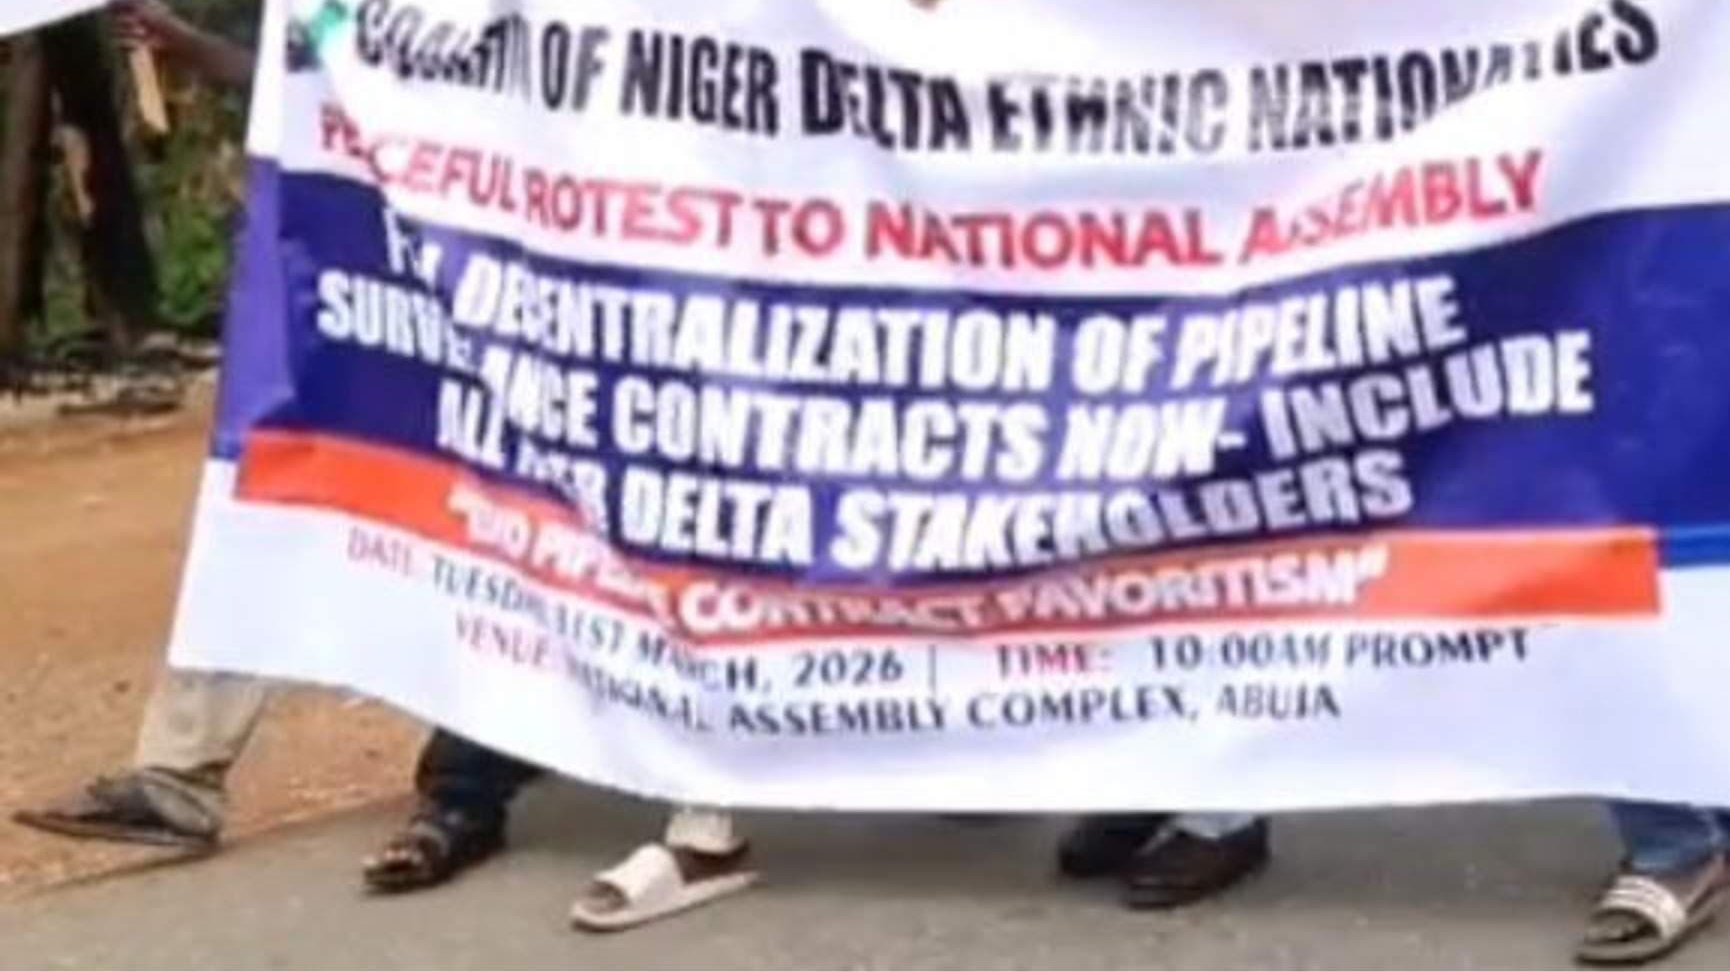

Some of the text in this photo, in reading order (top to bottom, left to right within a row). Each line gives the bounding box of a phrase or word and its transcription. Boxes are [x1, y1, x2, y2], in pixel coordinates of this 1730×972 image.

[541, 20, 610, 112] OF
[619, 28, 780, 136] NIGER
[799, 46, 971, 156] DELTA
[986, 68, 1229, 156] ETHNIC
[523, 166, 741, 251] ROTEST
[753, 193, 846, 258] TO
[864, 200, 1227, 271] NATIONAL
[1071, 312, 1168, 393] OF
[1171, 274, 1467, 389] PIPELINE
[611, 375, 1051, 483] CONTRACTS
[1056, 396, 1247, 481] NOW-
[1260, 329, 1596, 459] INCLUDE
[620, 465, 813, 565] DELTA
[829, 448, 1416, 574] STAKEHOLDERS
[729, 694, 947, 738] ASSEMBLY
[966, 683, 1199, 730] COMPLEX,
[1214, 681, 1341, 720] ABUJA
[793, 647, 904, 688] 2026
[997, 640, 1112, 678] TIME:
[1344, 626, 1530, 669] PROMPT
